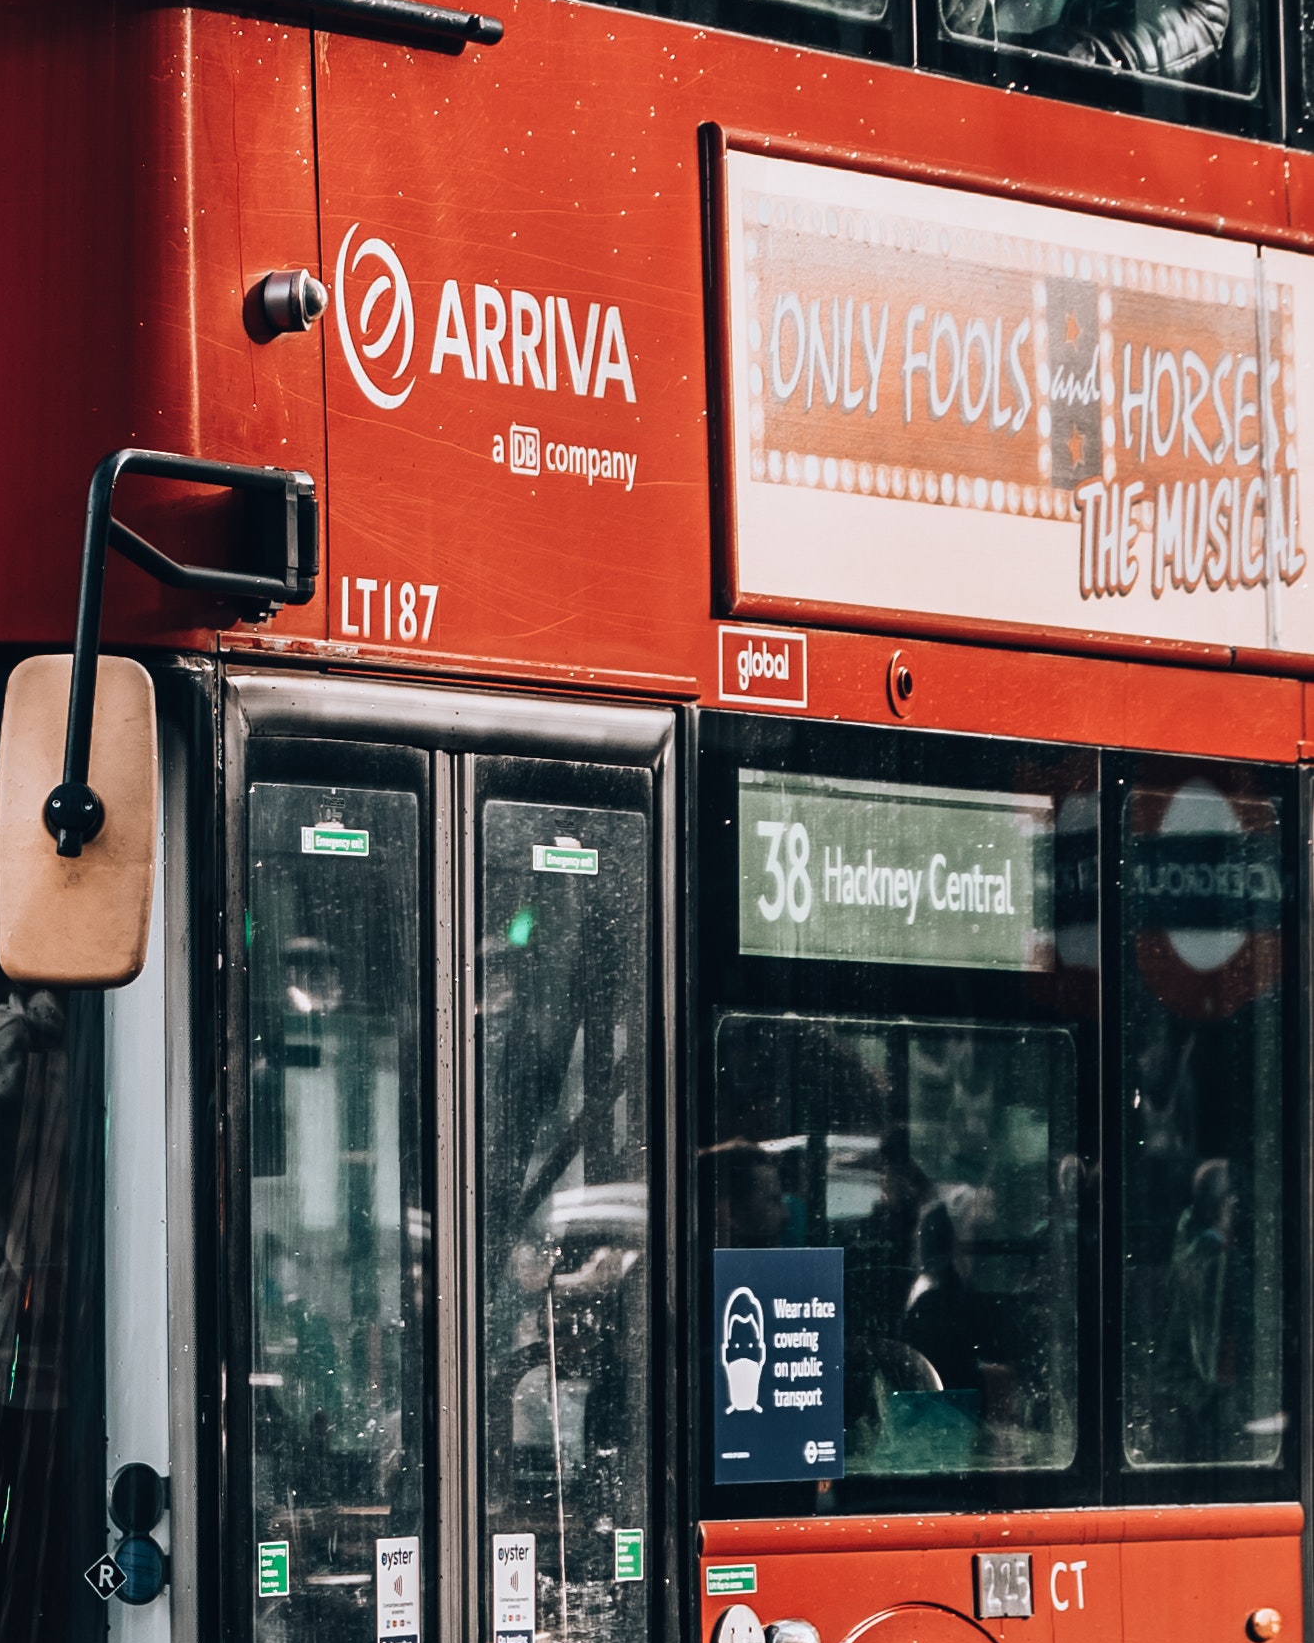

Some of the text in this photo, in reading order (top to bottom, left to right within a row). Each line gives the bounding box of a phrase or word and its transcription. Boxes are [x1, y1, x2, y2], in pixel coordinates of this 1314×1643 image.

[430, 280, 637, 403] ARRIVA
[771, 291, 1034, 433] ONLY FOOLS
[1050, 343, 1103, 405] and
[1121, 344, 1280, 470] HORSES
[492, 428, 637, 491] a DB company
[1077, 472, 1306, 600] THE MUSICAL
[341, 576, 438, 644] LT187
[738, 639, 789, 690] global
[315, 835, 350, 850] Emergency
[757, 821, 1014, 925] 38 Hackney Central
[774, 1297, 835, 1319] Wear a face
[774, 1328, 819, 1352] covering
[774, 1357, 823, 1382] on public
[774, 1387, 823, 1411] transport
[99, 1564, 114, 1588] R
[381, 1546, 414, 1571] oyster
[498, 1544, 529, 1566] oyster
[1050, 1560, 1087, 1611] CT
